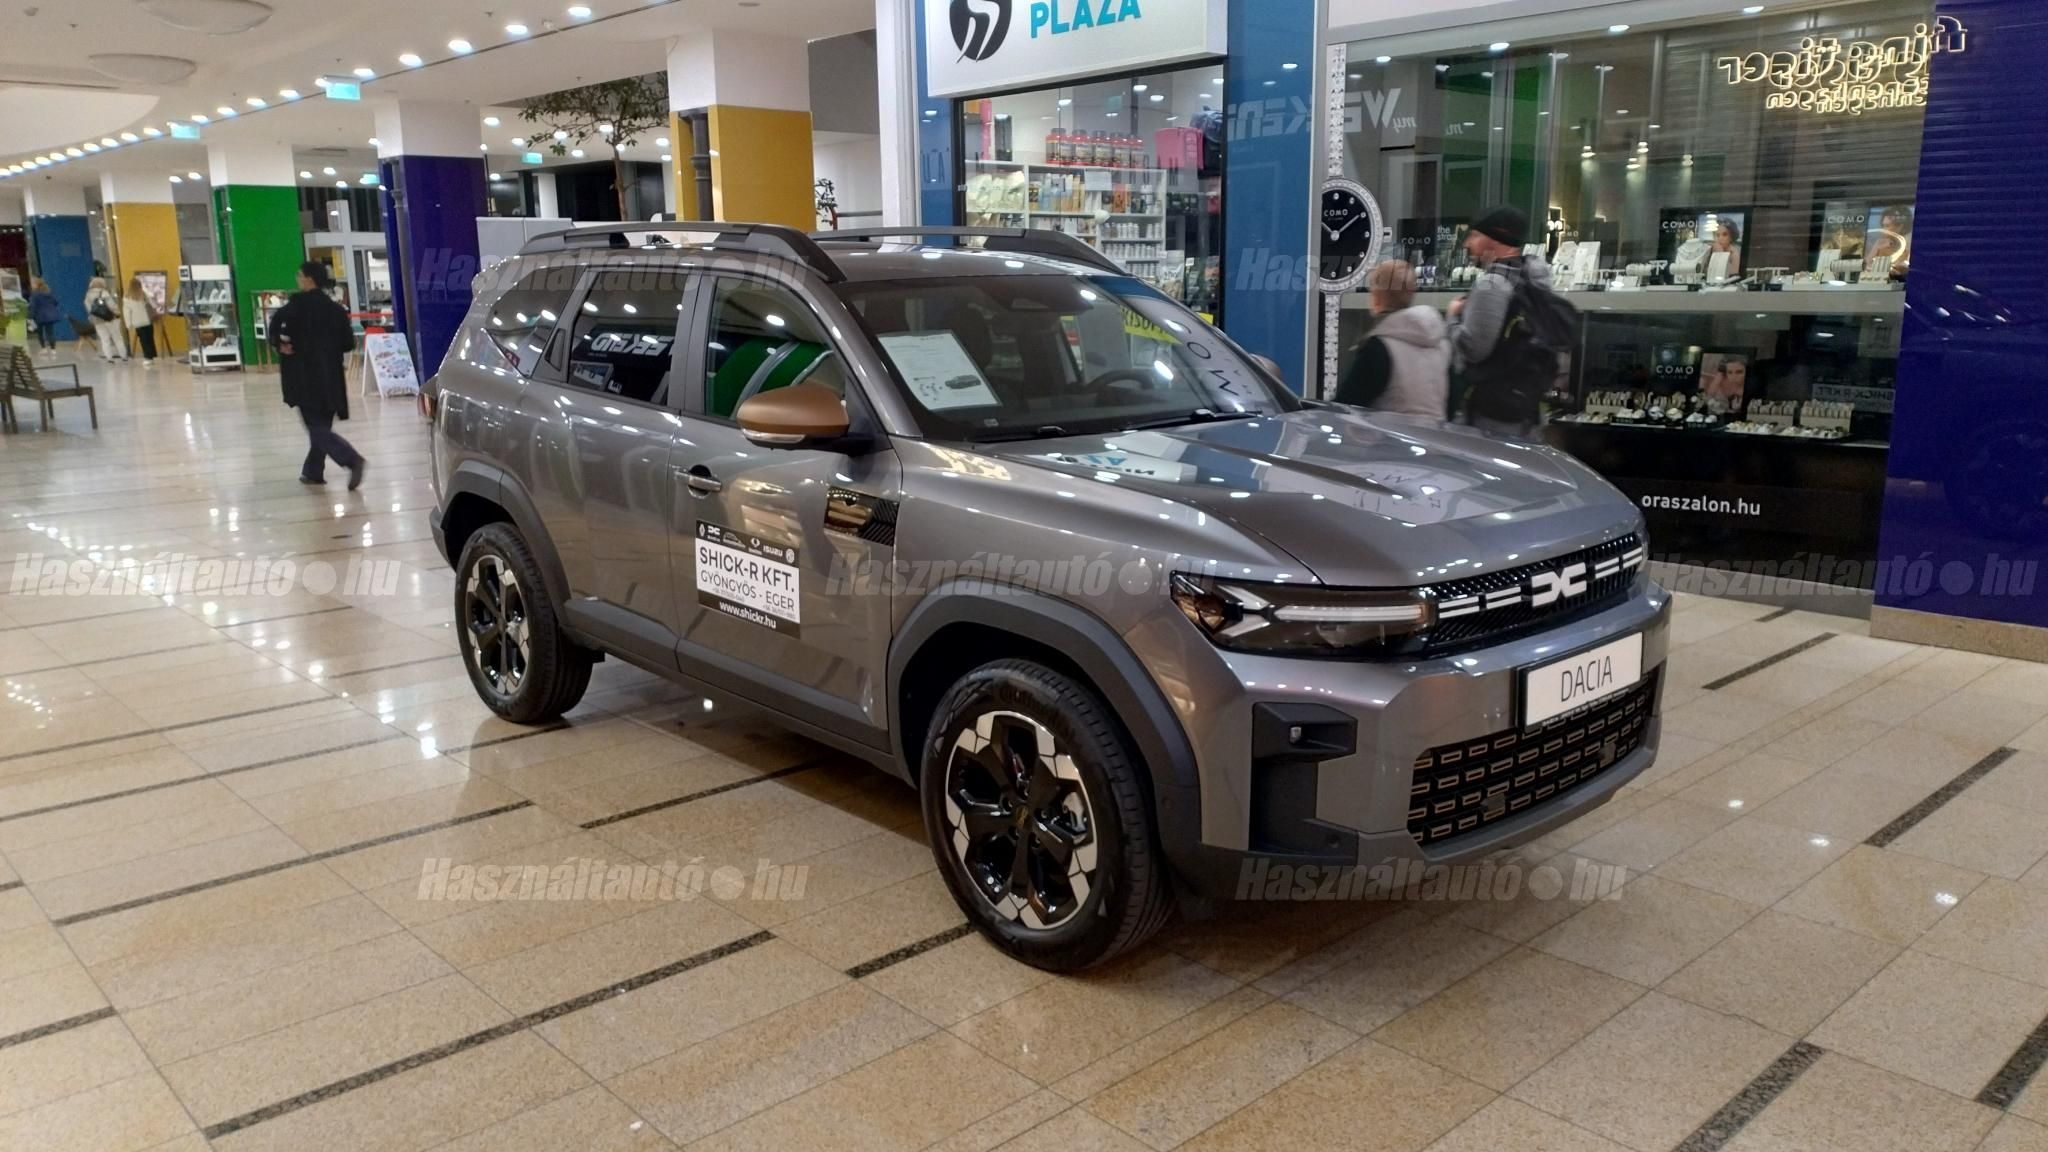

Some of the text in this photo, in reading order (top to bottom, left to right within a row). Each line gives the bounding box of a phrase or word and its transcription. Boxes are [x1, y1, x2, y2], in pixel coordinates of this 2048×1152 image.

[1031, 0, 1141, 38] PLAZA
[1323, 209, 1348, 217] COMO
[1828, 215, 1864, 224] COMO
[1662, 221, 1695, 229] COMO
[1401, 236, 1431, 246] COMO
[1656, 365, 1694, 375] COMO
[1641, 495, 1760, 515] oraszalon.hu
[700, 546, 758, 581] SHICK-R
[762, 564, 795, 593] KFT.
[765, 590, 794, 611] EGER
[719, 601, 776, 629] www.shickr.hu
[1561, 655, 1613, 702] DACIA
